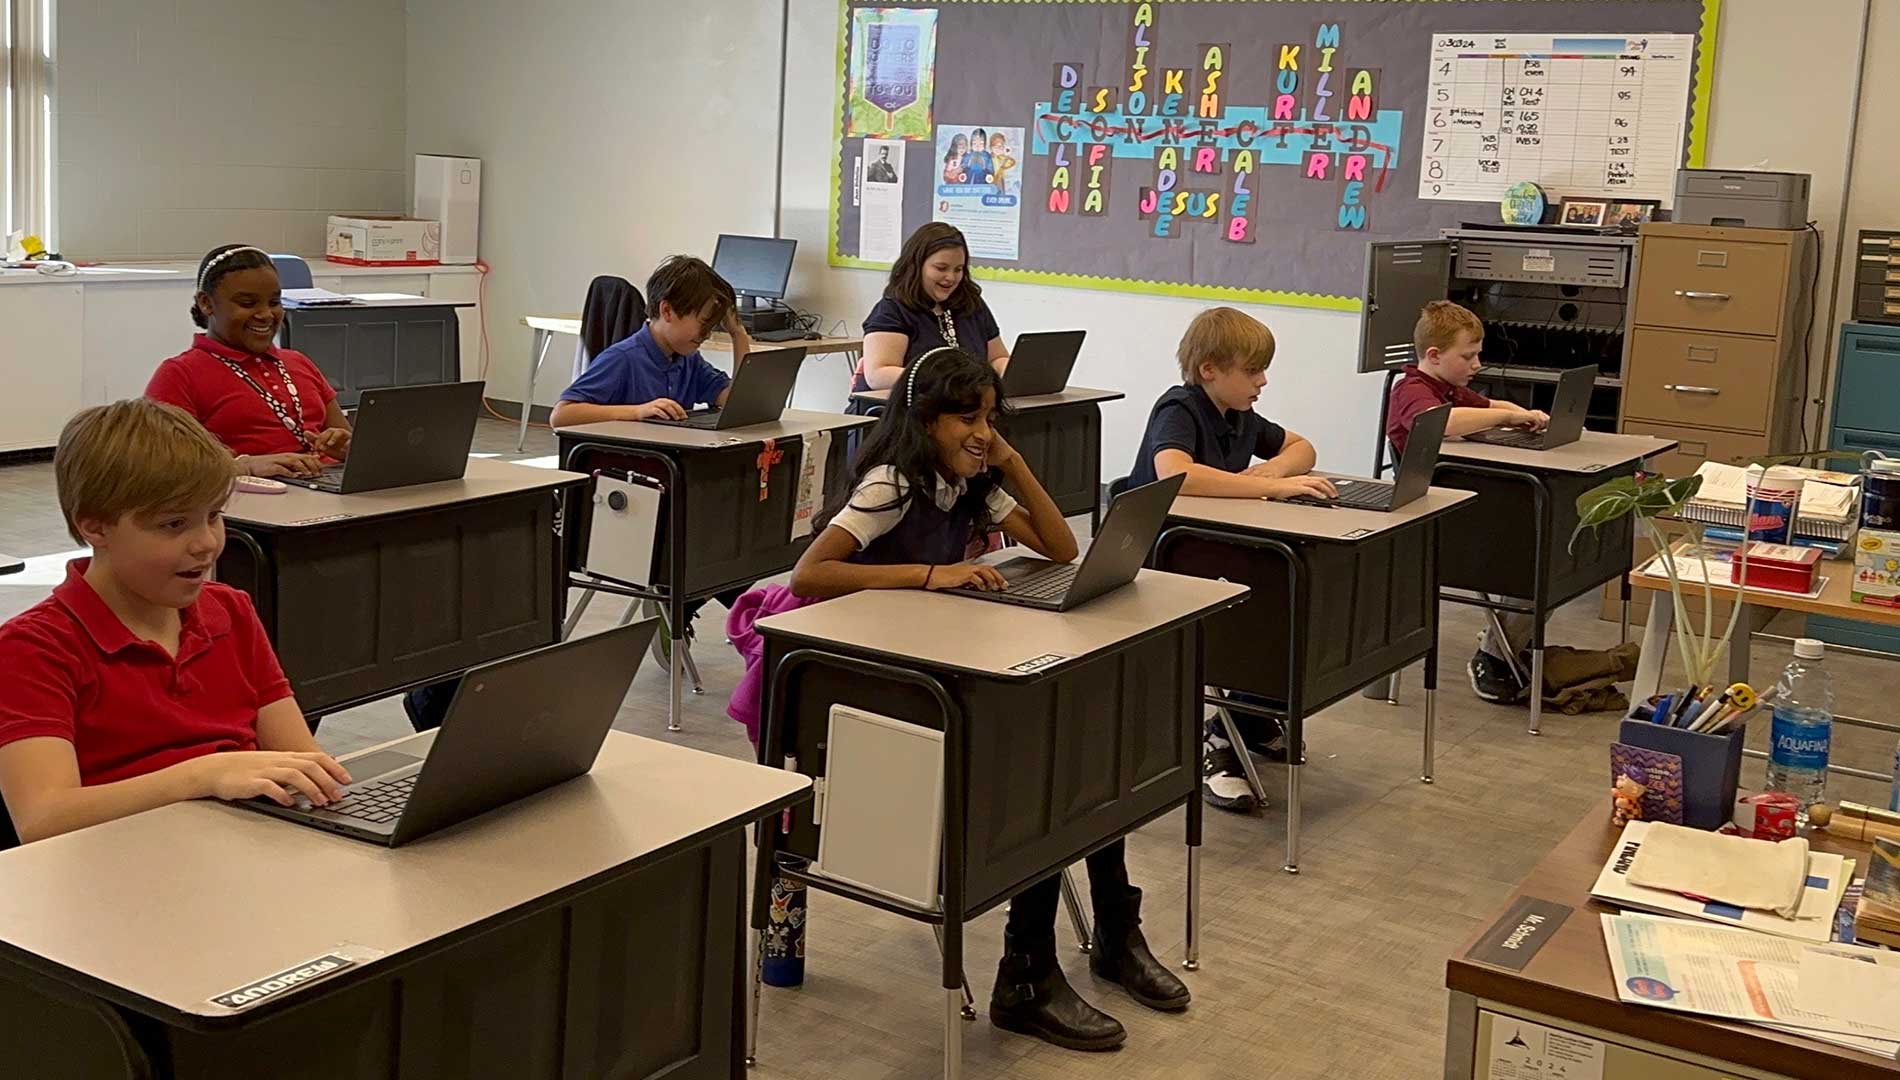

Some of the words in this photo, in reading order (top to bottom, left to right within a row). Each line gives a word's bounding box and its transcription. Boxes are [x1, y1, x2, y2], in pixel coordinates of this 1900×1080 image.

[1124, 3, 1153, 144] ALISON
[1438, 62, 1452, 76] 4
[1195, 46, 1223, 173] ASHER
[1272, 45, 1301, 149] KURT
[1307, 23, 1340, 180] MILLER
[1437, 89, 1449, 102] 5
[1049, 64, 1078, 213] DECLAN
[1056, 115, 1372, 153] CONNECTED
[1433, 112, 1447, 128] 6
[1084, 88, 1109, 213] SOFIA
[1338, 70, 1372, 230] ANDREW
[1432, 139, 1444, 152] 7
[1228, 120, 1257, 241] CALEB
[1428, 160, 1444, 179] 8
[1140, 191, 1220, 218] JESUS
[1432, 184, 1441, 196] 9
[1501, 924, 1537, 949] Schmidt
[1522, 914, 1546, 924] Mr.
[230, 960, 340, 1005] ANDREW
